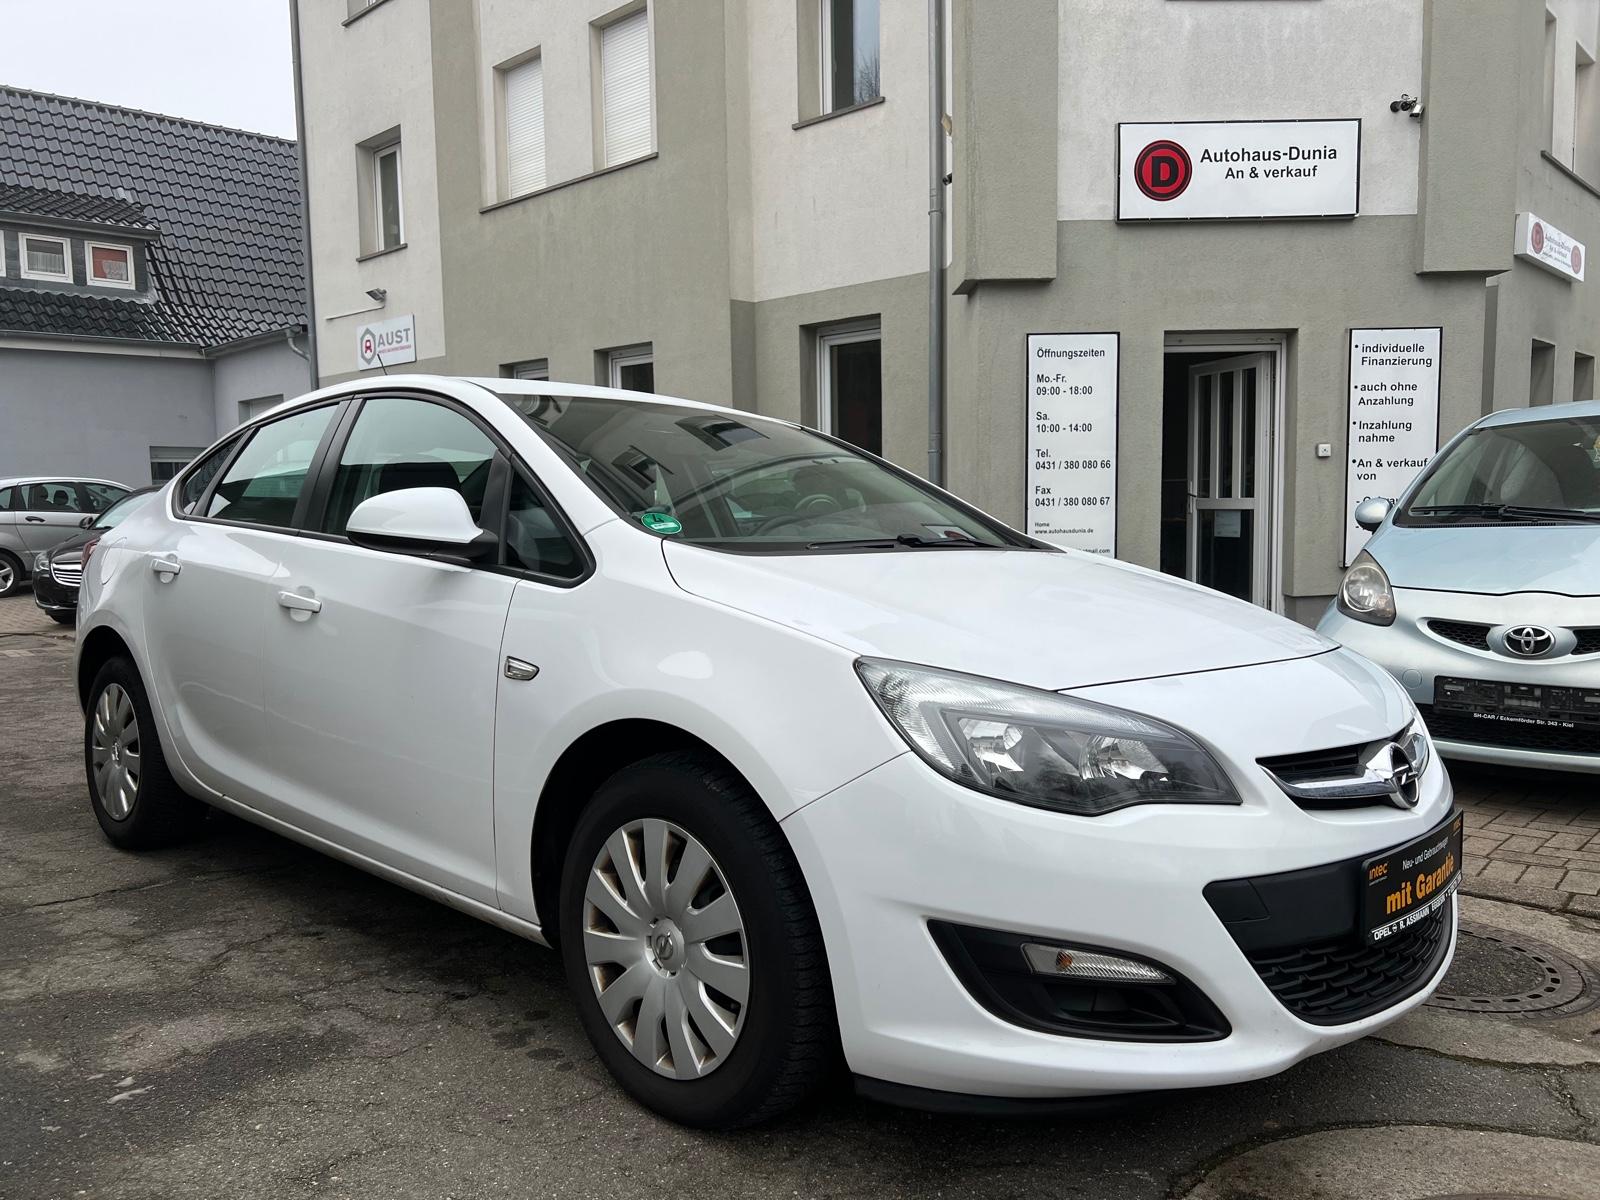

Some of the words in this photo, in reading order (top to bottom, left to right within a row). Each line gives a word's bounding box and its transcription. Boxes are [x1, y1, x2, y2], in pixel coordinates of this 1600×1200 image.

[1200, 146, 1337, 163] Autohaus-Dunia
[1151, 155, 1179, 187] D
[1225, 167, 1244, 179] An
[1249, 166, 1260, 179] &
[1264, 165, 1318, 178] verkauf
[377, 328, 411, 348] AUST
[1036, 347, 1105, 360] Öffnungszeiten
[1361, 343, 1425, 353] individuelle
[1361, 356, 1433, 367] Finanzierung
[1036, 373, 1067, 384] Mo.-Fr.
[1036, 386, 1061, 395] 09:00
[1069, 386, 1093, 395] 18:00
[1360, 382, 1387, 392] auch
[1390, 381, 1418, 392] ohne
[1358, 396, 1414, 407] Anzahlung
[1036, 411, 1050, 421] Sa.
[1036, 424, 1061, 433] 10:00
[1068, 423, 1093, 432] 14:00
[1358, 419, 1412, 431] Inzahlung
[1358, 433, 1395, 443] nahme
[1036, 448, 1051, 458] Tel.
[1035, 460, 1056, 470] 0431
[1064, 460, 1080, 470] 380
[1081, 460, 1098, 469] 080
[1100, 459, 1111, 469] 66
[1357, 458, 1372, 468] An
[1375, 458, 1383, 468] &
[1386, 458, 1428, 468] verkauf
[1356, 472, 1377, 481] von
[1035, 485, 1052, 495] Fax
[1035, 497, 1056, 507] 0431
[1063, 497, 1079, 507] 380
[1081, 497, 1098, 506] 080
[1099, 496, 1110, 506] 67
[1386, 881, 1412, 914] mit
[1416, 851, 1454, 899] Garantie
[1373, 926, 1392, 941] OPEL
